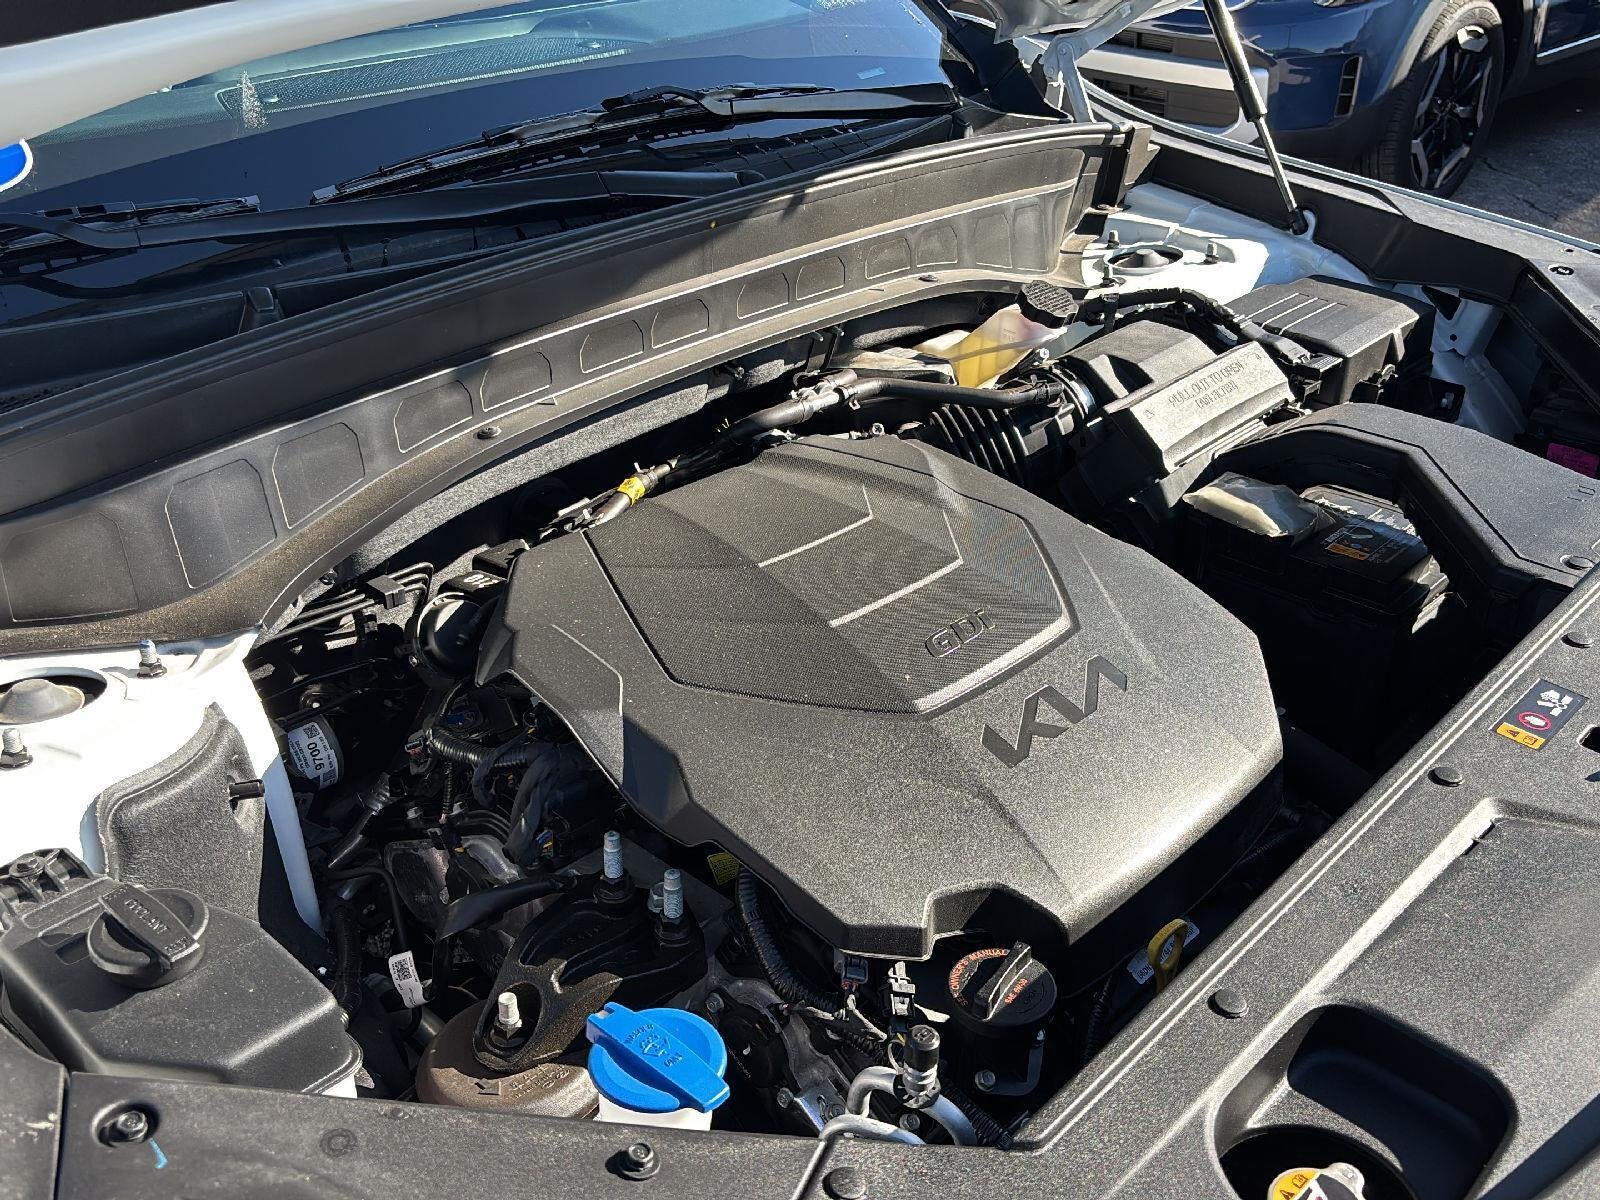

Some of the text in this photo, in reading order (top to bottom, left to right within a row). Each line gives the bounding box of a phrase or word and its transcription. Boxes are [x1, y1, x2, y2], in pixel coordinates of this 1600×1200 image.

[1191, 377, 1211, 396] OUT
[1208, 371, 1222, 386] TO
[981, 655, 1128, 769] KIA
[306, 742, 325, 771] 9700
[968, 948, 1010, 961] MANUAL
